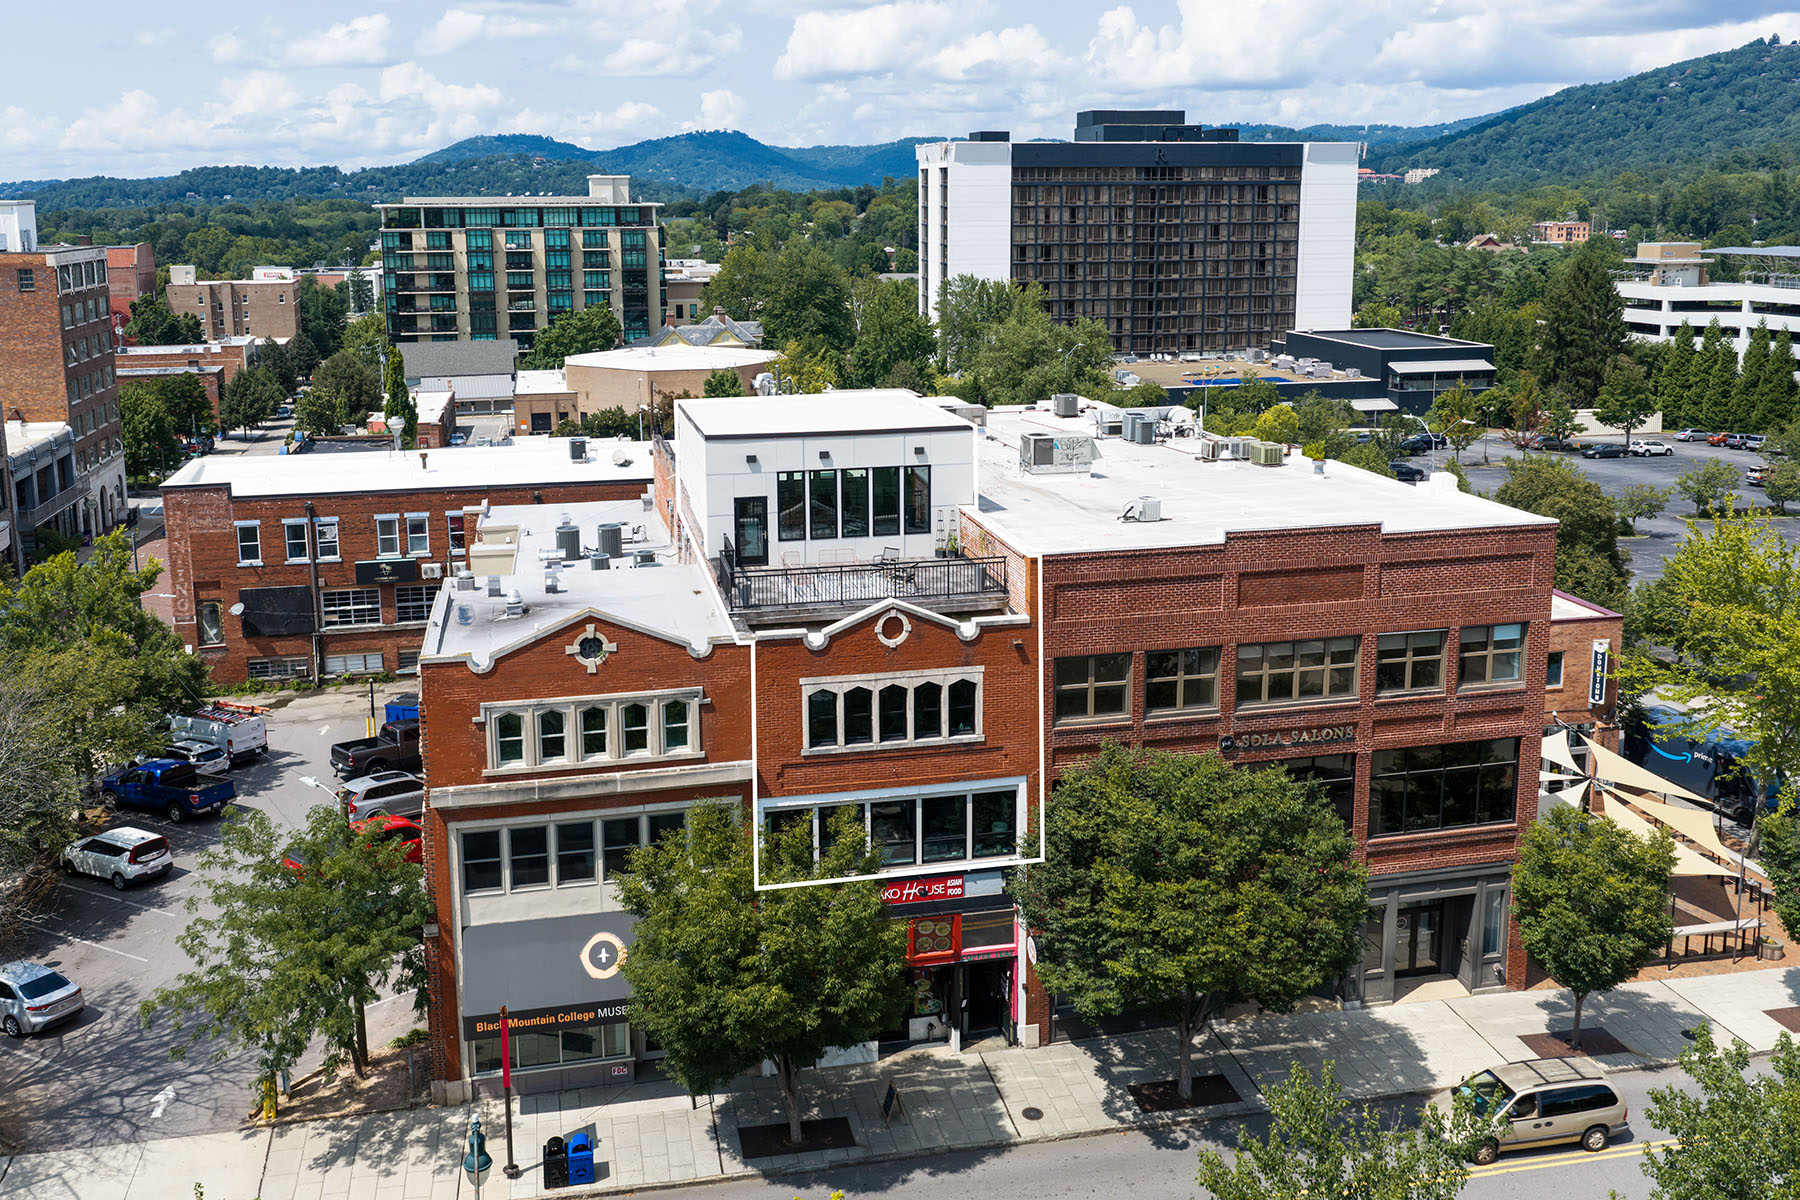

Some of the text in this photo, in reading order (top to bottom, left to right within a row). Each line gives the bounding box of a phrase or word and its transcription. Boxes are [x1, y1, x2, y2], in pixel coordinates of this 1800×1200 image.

[1241, 725, 1354, 747] SOLA SALONS
[1693, 751, 1714, 764] prime
[946, 878, 963, 887] ASIAN
[903, 882, 946, 901] HOUSE
[947, 887, 962, 896] FOOD
[961, 952, 991, 961] COFFEE
[476, 1018, 504, 1032] Blac
[508, 1014, 555, 1028] Mountain
[557, 1011, 595, 1023] College
